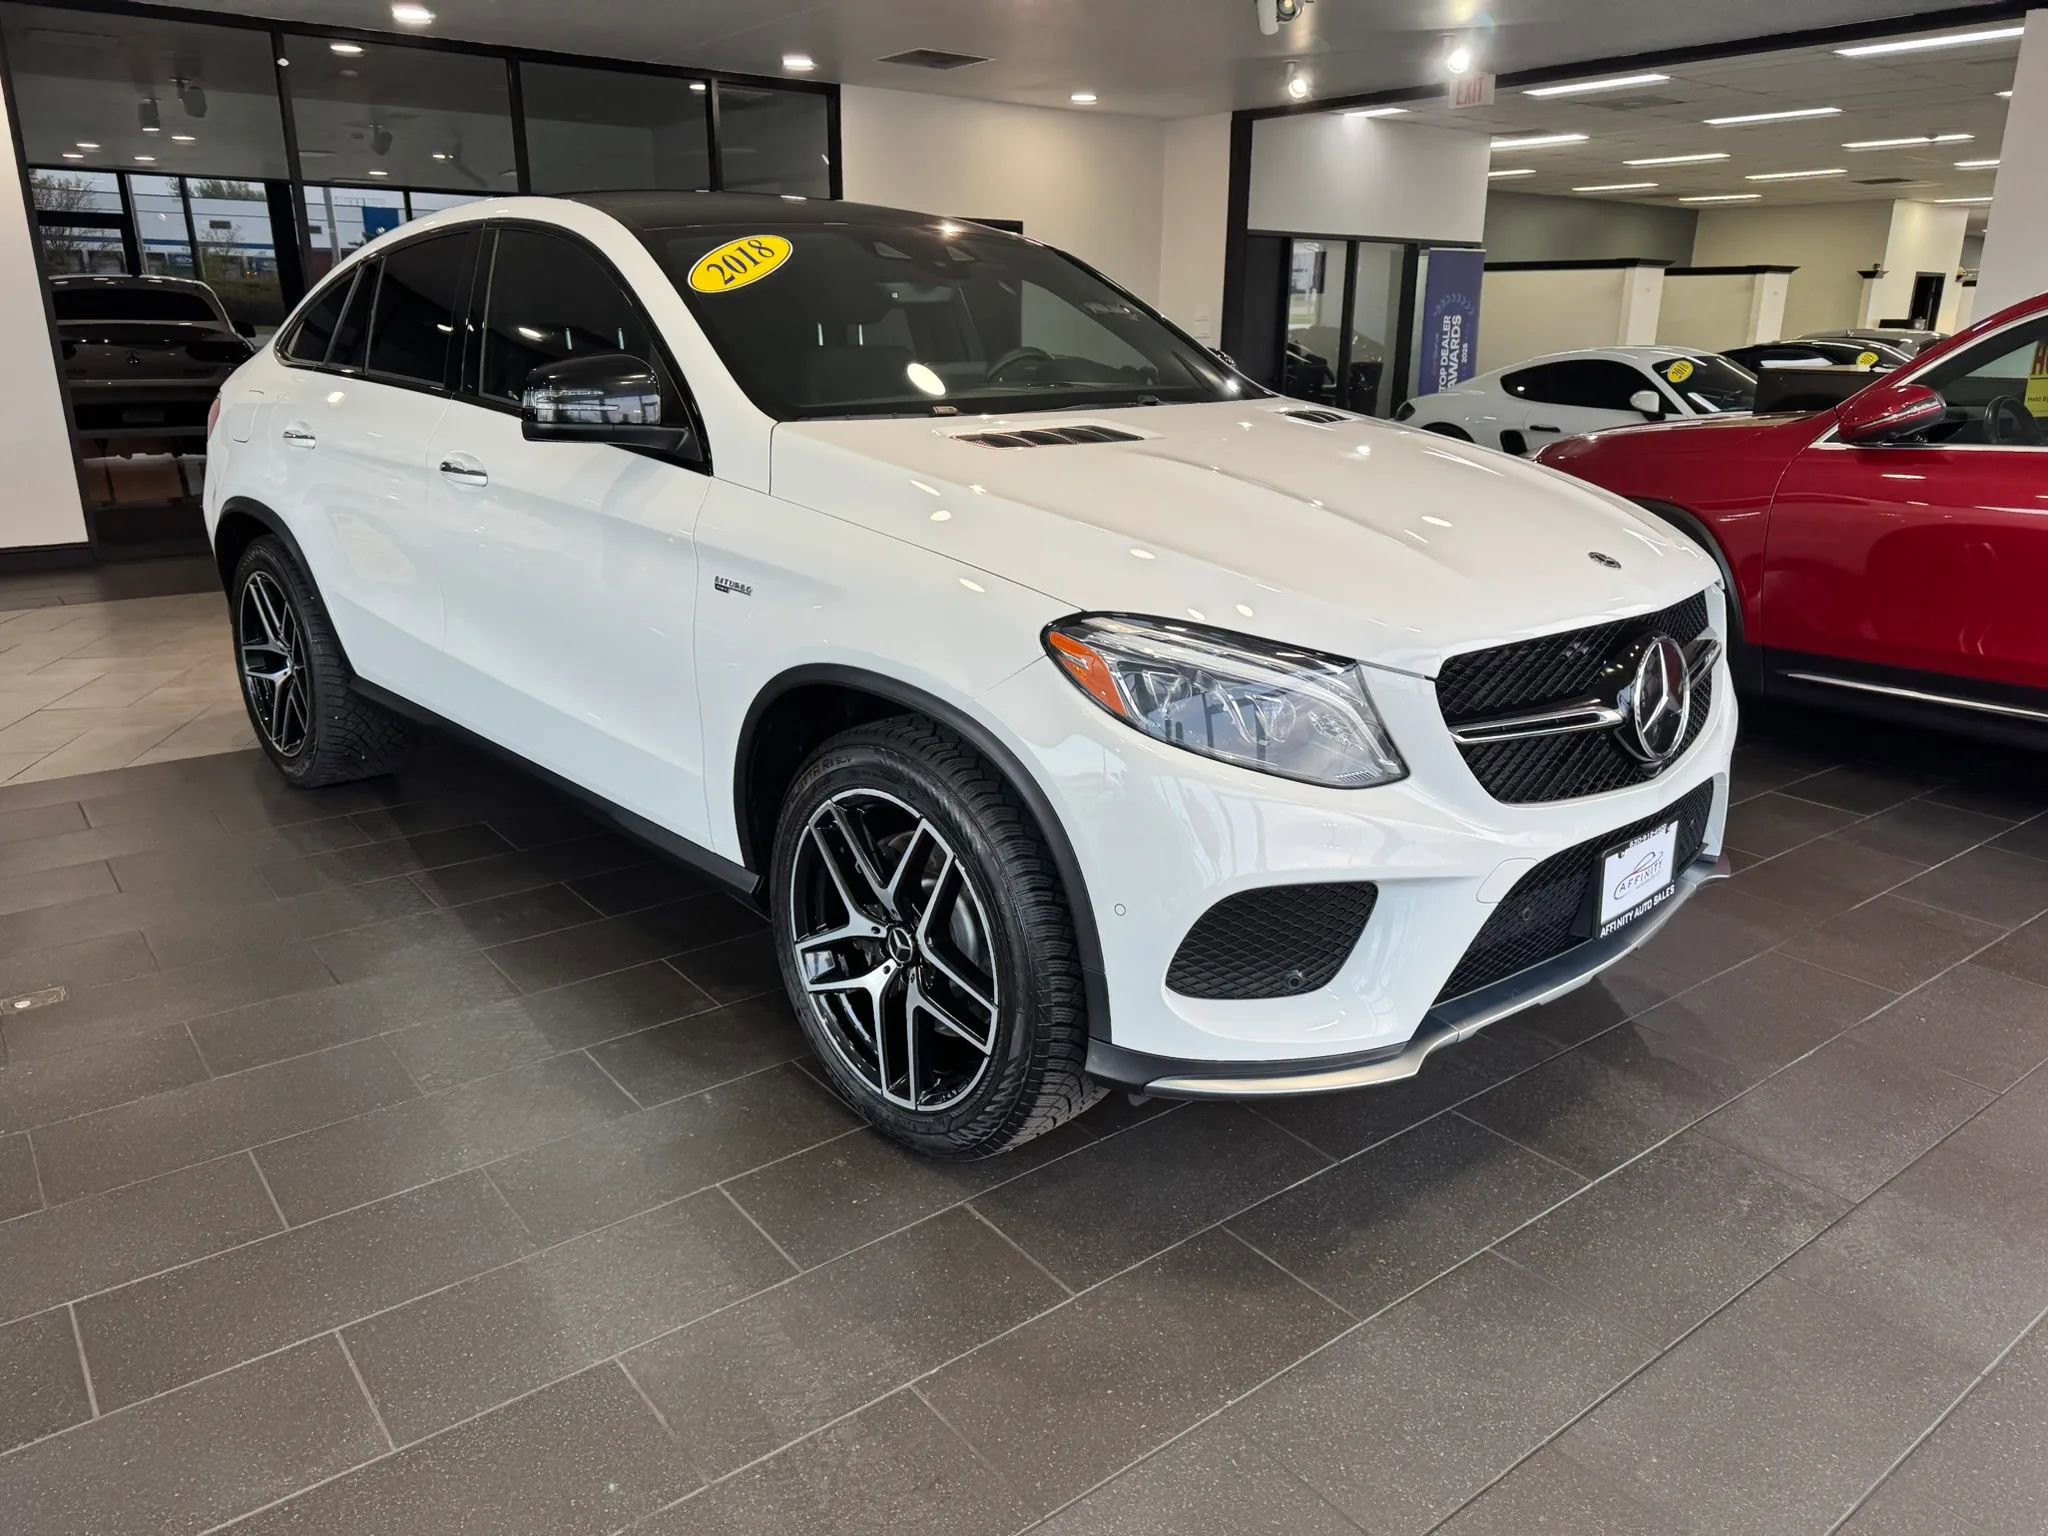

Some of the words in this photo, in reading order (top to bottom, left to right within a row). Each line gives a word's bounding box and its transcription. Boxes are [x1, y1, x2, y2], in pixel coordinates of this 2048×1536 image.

[706, 239, 775, 286] 2018
[1440, 315, 1452, 365] DEALER
[1447, 314, 1462, 389] AWARDS
[1438, 366, 1448, 393] TOP
[1618, 860, 1664, 893] AFFINITY
[1600, 911, 1634, 939] AFFINITY
[1634, 898, 1653, 919] AUTO
[1653, 884, 1675, 906] SALES
